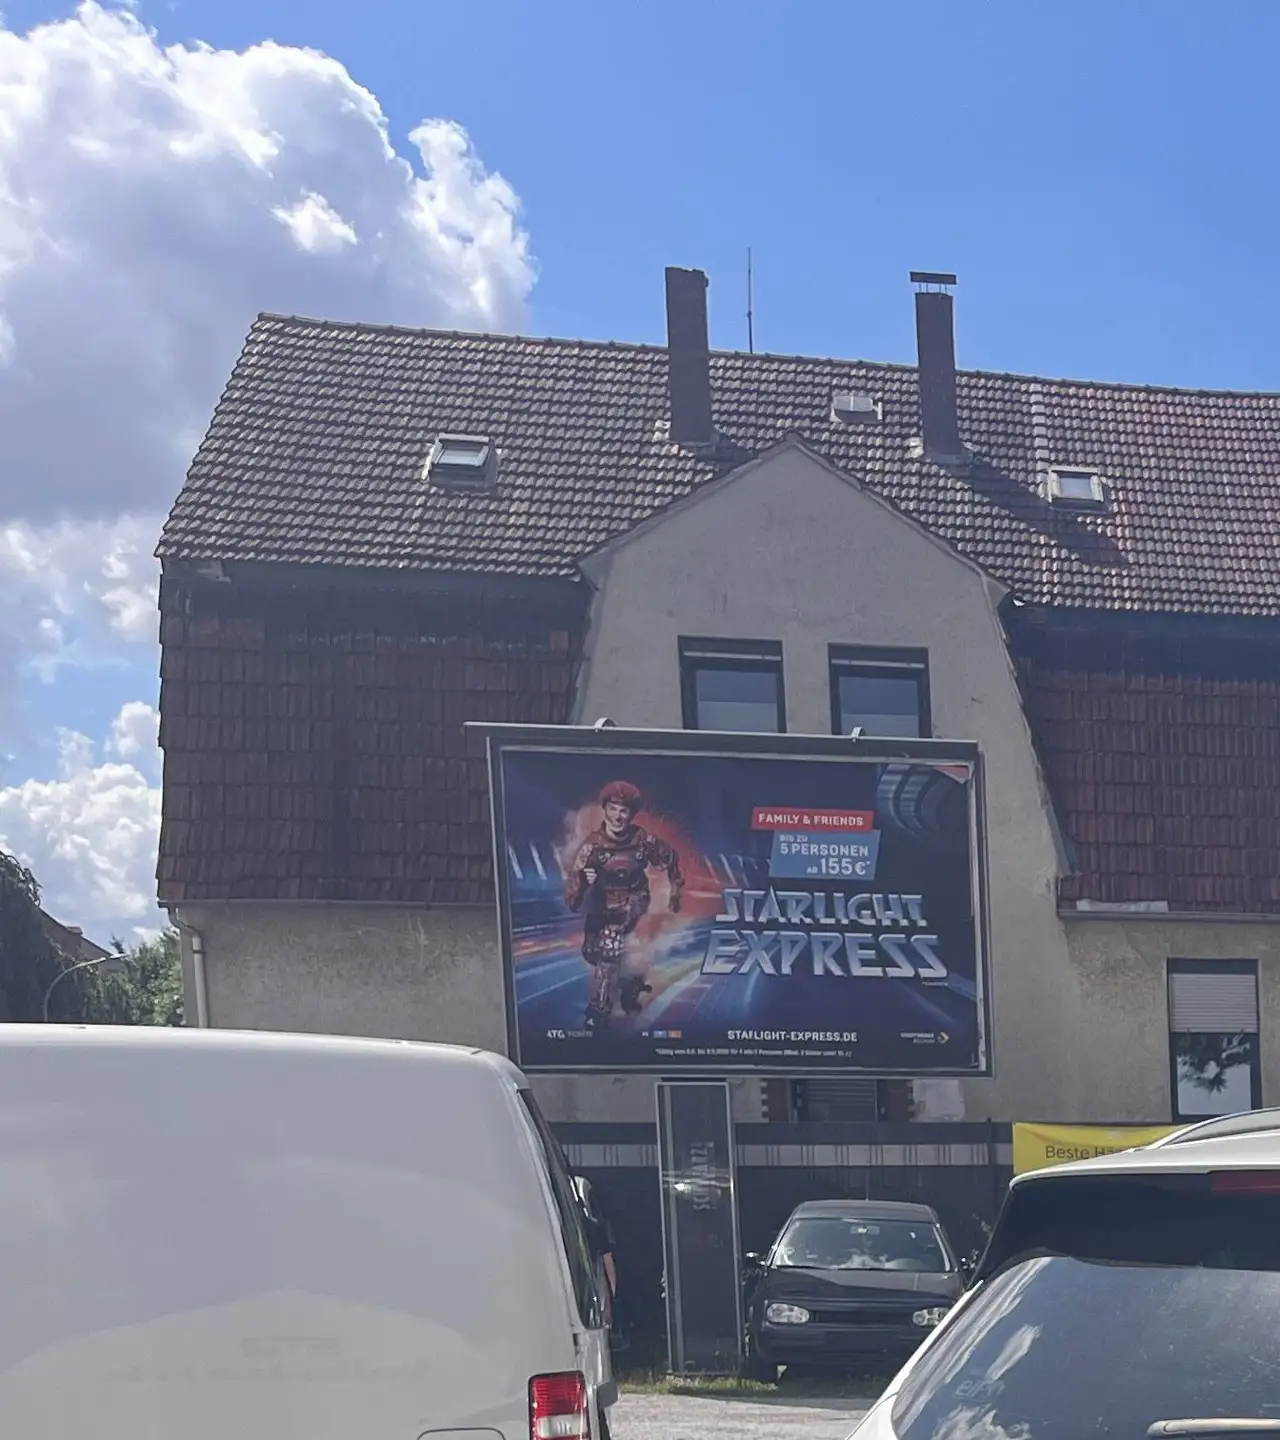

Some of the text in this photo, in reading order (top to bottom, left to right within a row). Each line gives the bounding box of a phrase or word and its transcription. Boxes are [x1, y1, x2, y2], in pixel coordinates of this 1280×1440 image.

[758, 813, 864, 827] FAMILY & FRIENDS
[780, 843, 869, 857] 5 PERSONEN
[806, 866, 818, 874] AB
[715, 886, 927, 927] STARLIGHT
[702, 929, 948, 979] EXPRESS
[1045, 1145, 1090, 1160] Beste
